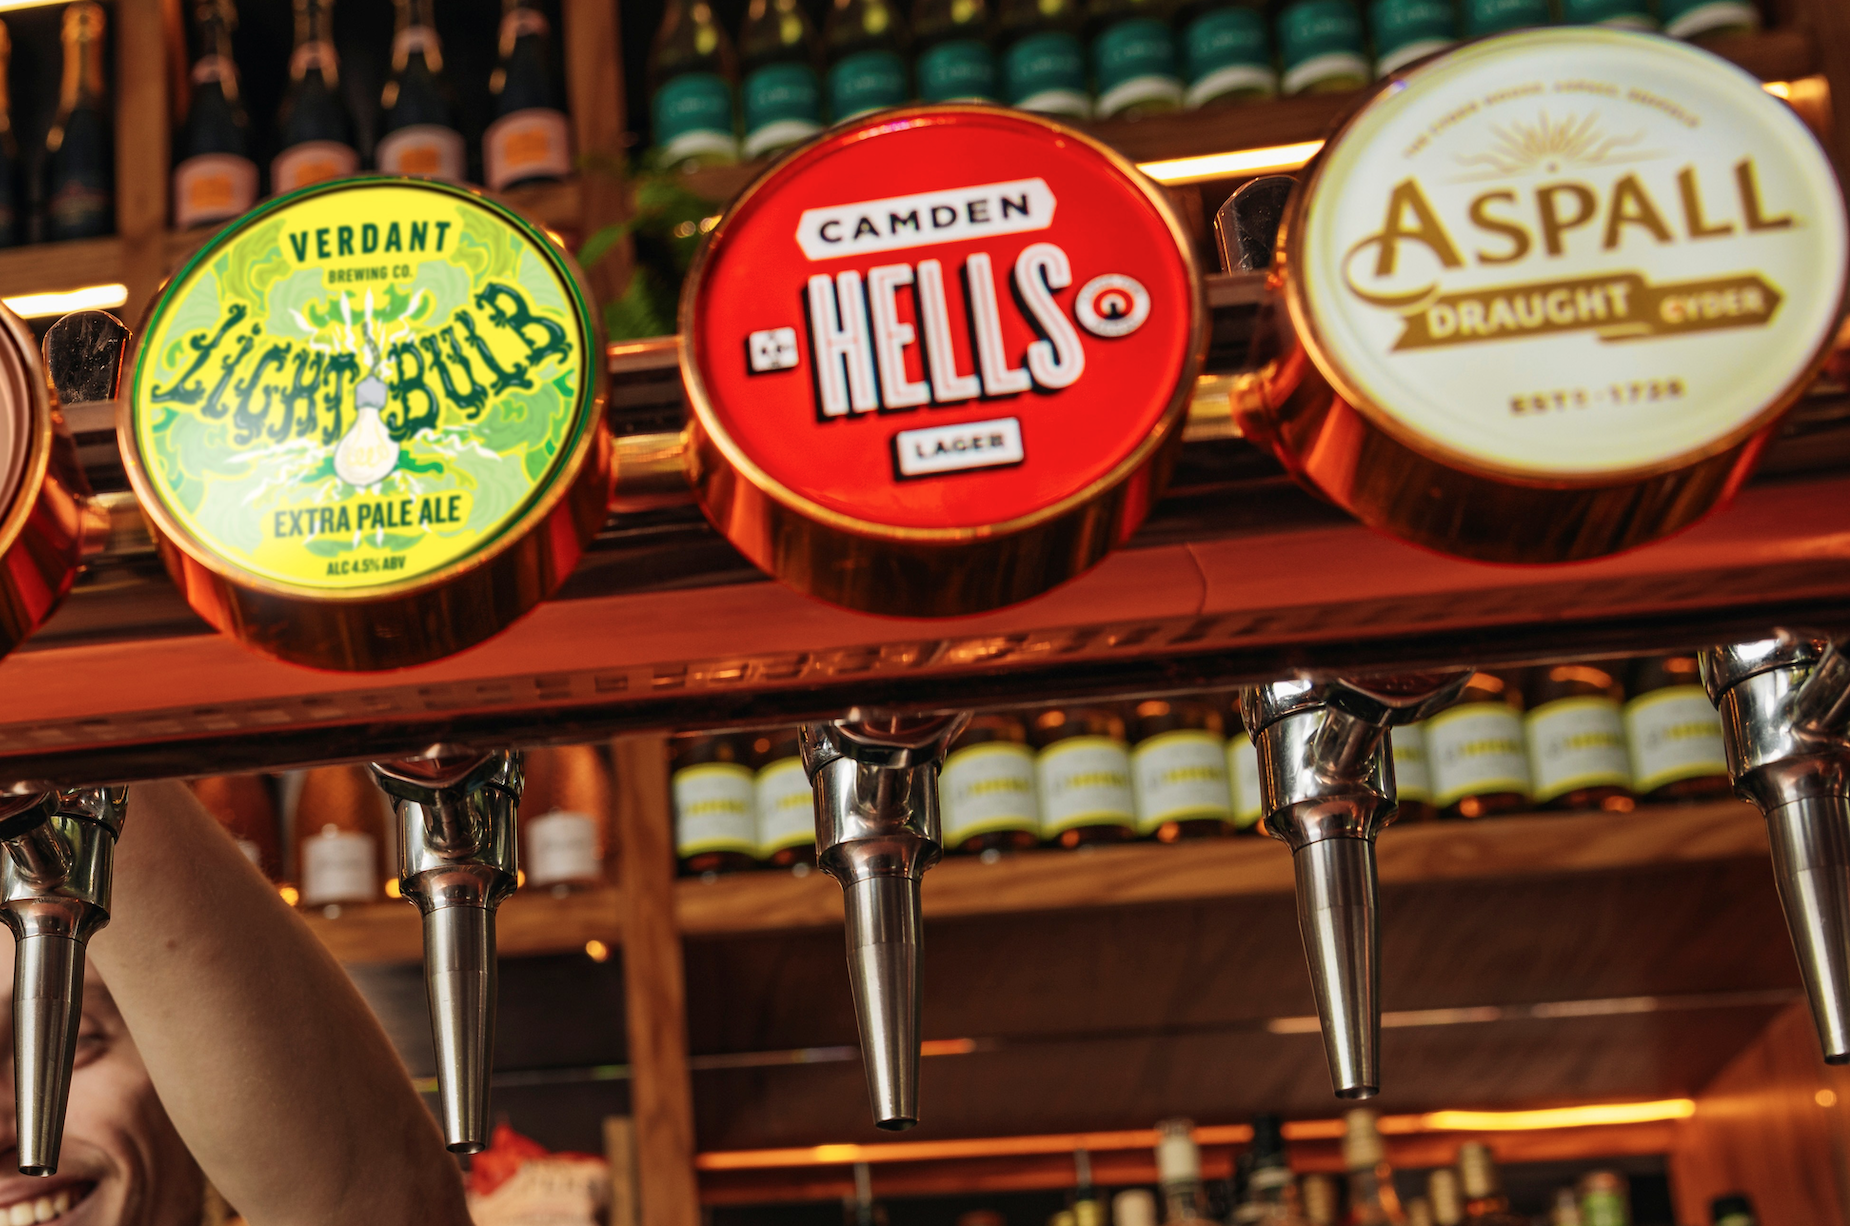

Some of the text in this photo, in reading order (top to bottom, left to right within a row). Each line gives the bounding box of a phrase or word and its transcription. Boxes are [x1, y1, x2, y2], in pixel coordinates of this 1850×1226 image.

[289, 221, 453, 263] VERDANT
[819, 192, 1033, 245] CAMDEN
[1342, 157, 1793, 312] ASPALL
[328, 264, 414, 285] BREWING CO.
[804, 242, 1086, 420] HELLS
[1427, 283, 1766, 339] DRAUGHT CYDER
[386, 282, 573, 443] BULB
[914, 433, 1005, 458] LAGER
[273, 494, 463, 538] EXTRA PALE ALE
[326, 555, 407, 576] ALC 4.5% ABV
